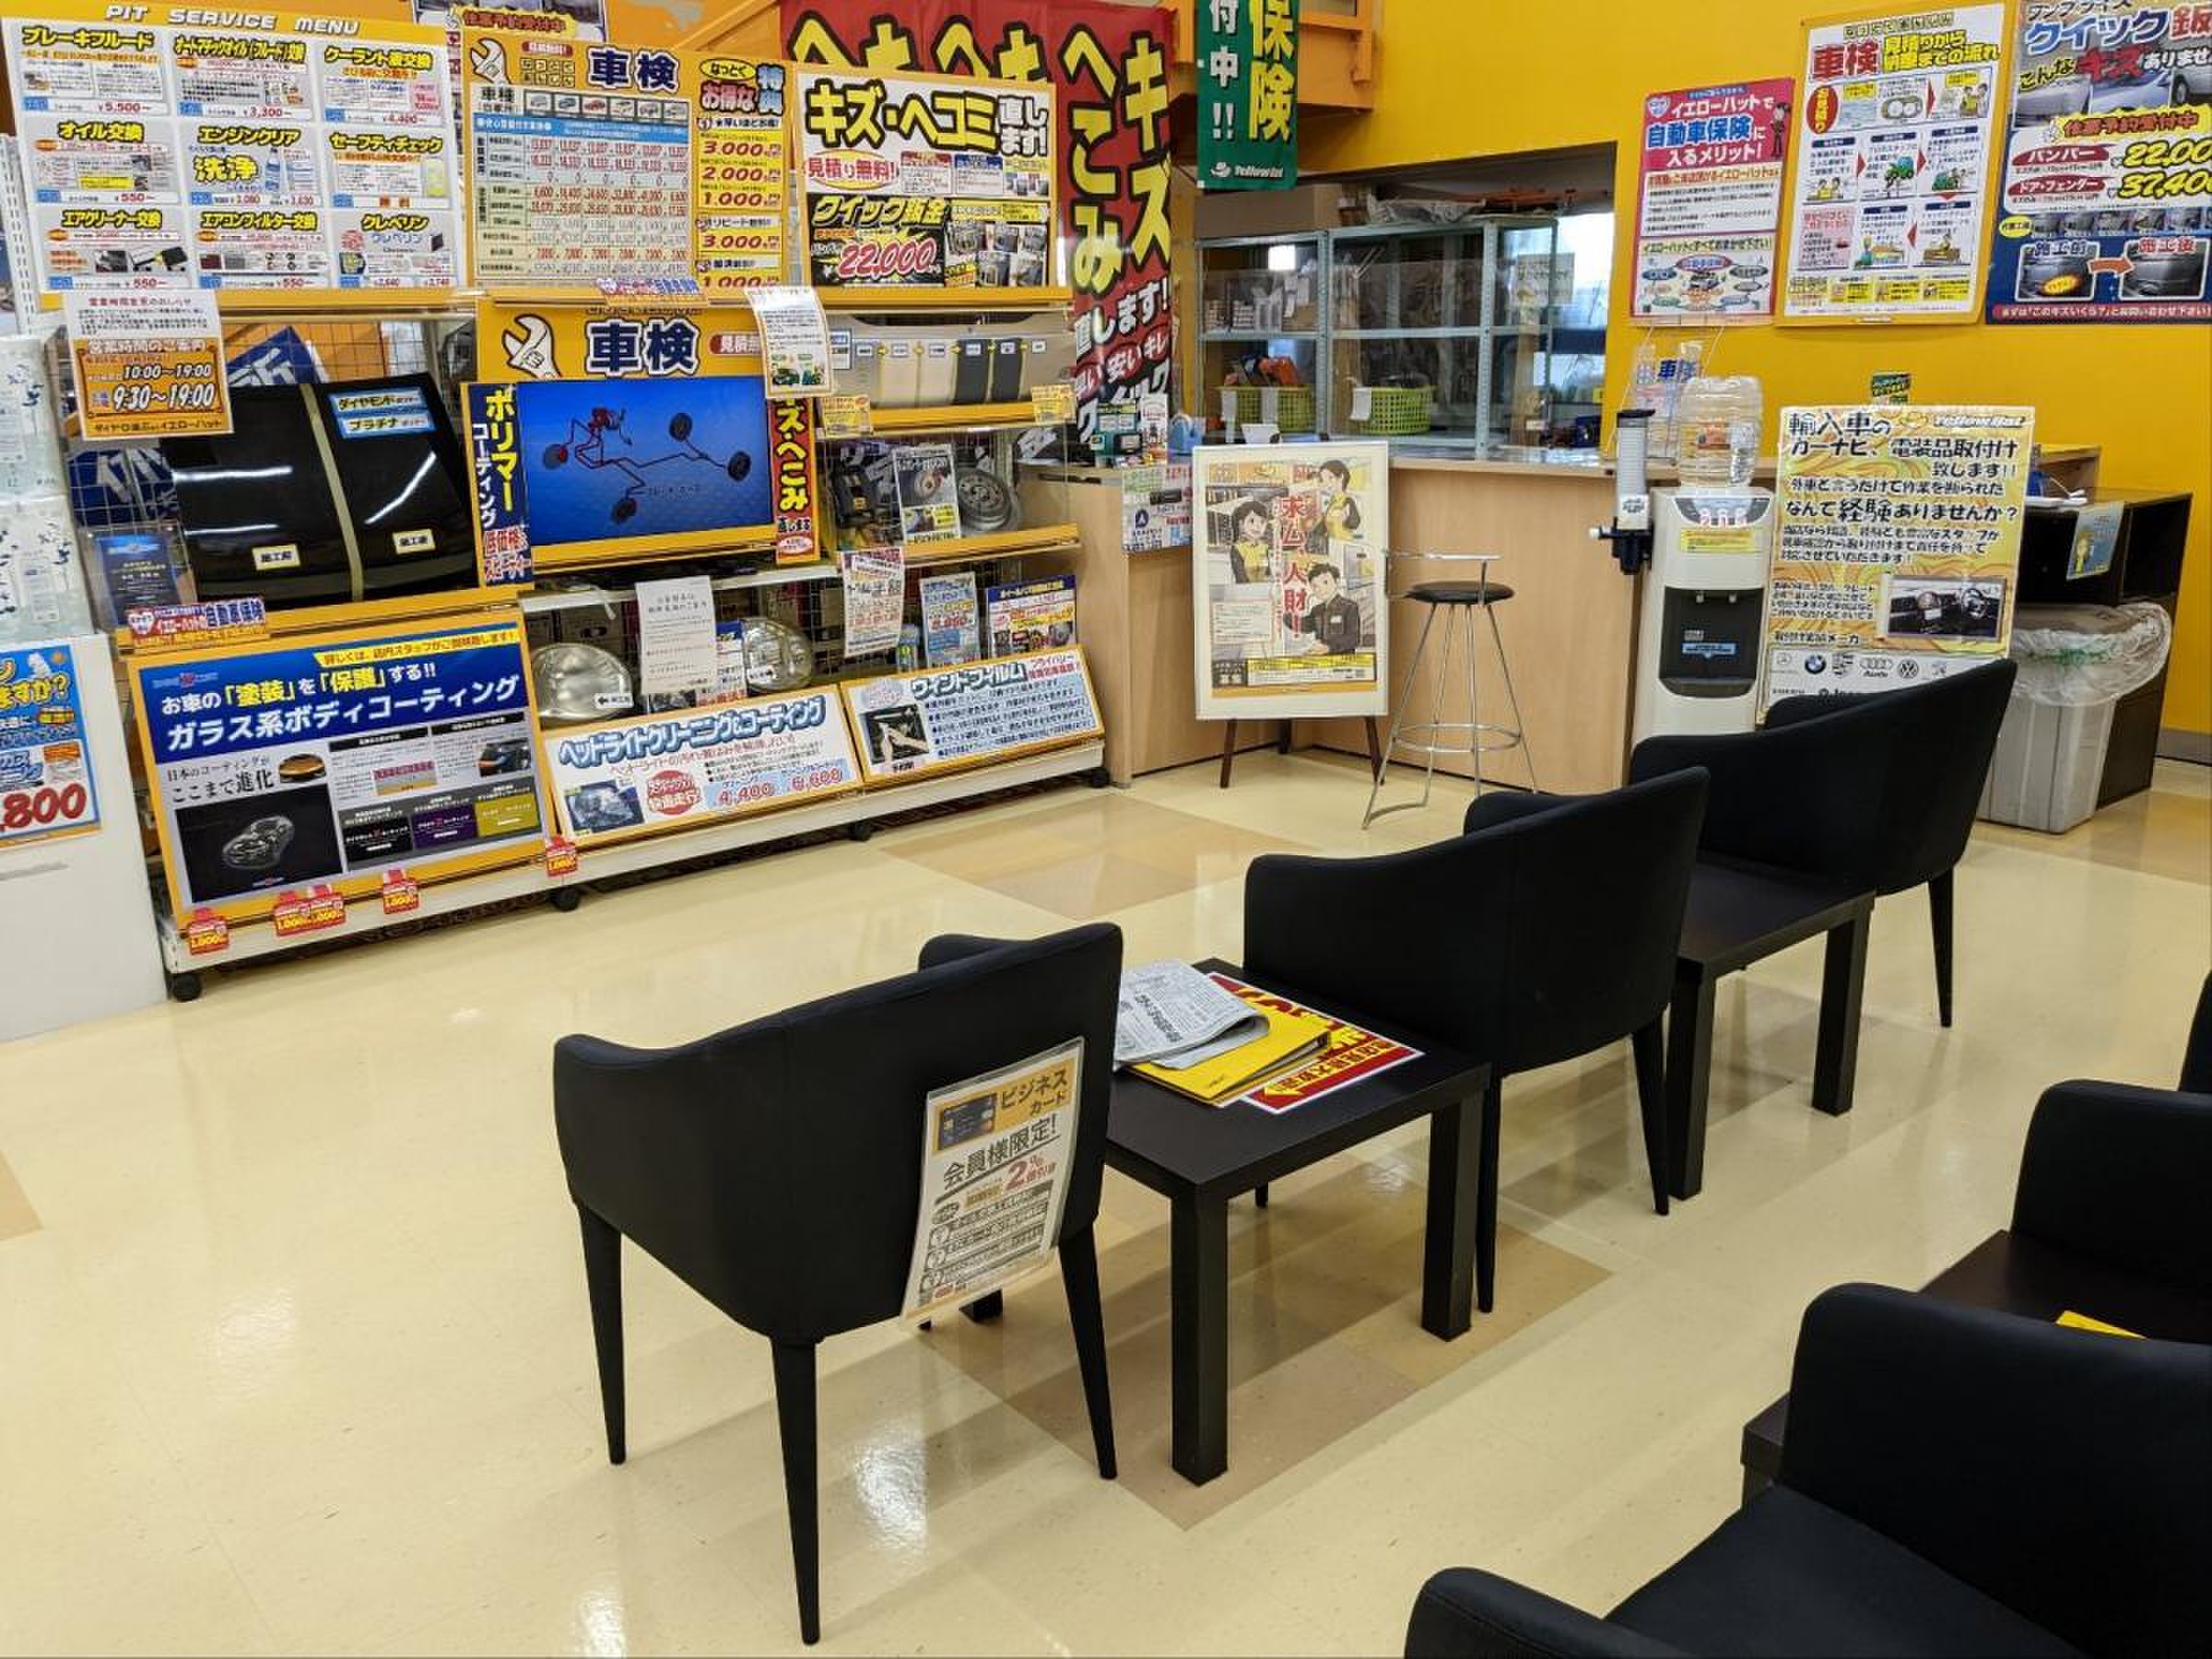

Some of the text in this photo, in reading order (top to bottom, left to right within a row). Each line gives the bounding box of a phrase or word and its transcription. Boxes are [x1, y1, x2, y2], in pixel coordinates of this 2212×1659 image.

[105, 6, 359, 35] PIT SERVICE MENU
[22, 26, 154, 51] ブレーキフルード
[588, 47, 679, 90] 車検
[1811, 40, 1880, 80] 車検
[806, 78, 999, 153] キズ・ヘコミ
[1672, 94, 1774, 118] イエローハットで
[58, 121, 144, 142] オイル交換
[196, 125, 300, 146] エンジンクリア
[330, 133, 442, 152] セーフティチェック
[194, 155, 259, 182] 洗浄
[1063, 26, 1121, 293] へこみ
[1666, 143, 1761, 167] 入るメリット!
[2028, 146, 2096, 164] バンパー
[62, 209, 162, 229] エアクリーナー交換
[198, 210, 317, 231] エアコンフィルター交換
[361, 213, 429, 230] クレベリン
[838, 237, 936, 278] 22,000
[586, 317, 700, 376] 車検
[1789, 412, 1890, 437] 輸入車の
[487, 385, 518, 512] ポリマー
[473, 423, 496, 527] コーティング
[168, 675, 520, 751] ガラス系ボディコーティング
[172, 770, 275, 803] ここまで進化
[1002, 1068, 1067, 1108] ビジネス
[1031, 1091, 1067, 1116] カード
[944, 1112, 1057, 1190] 会員様限定!
